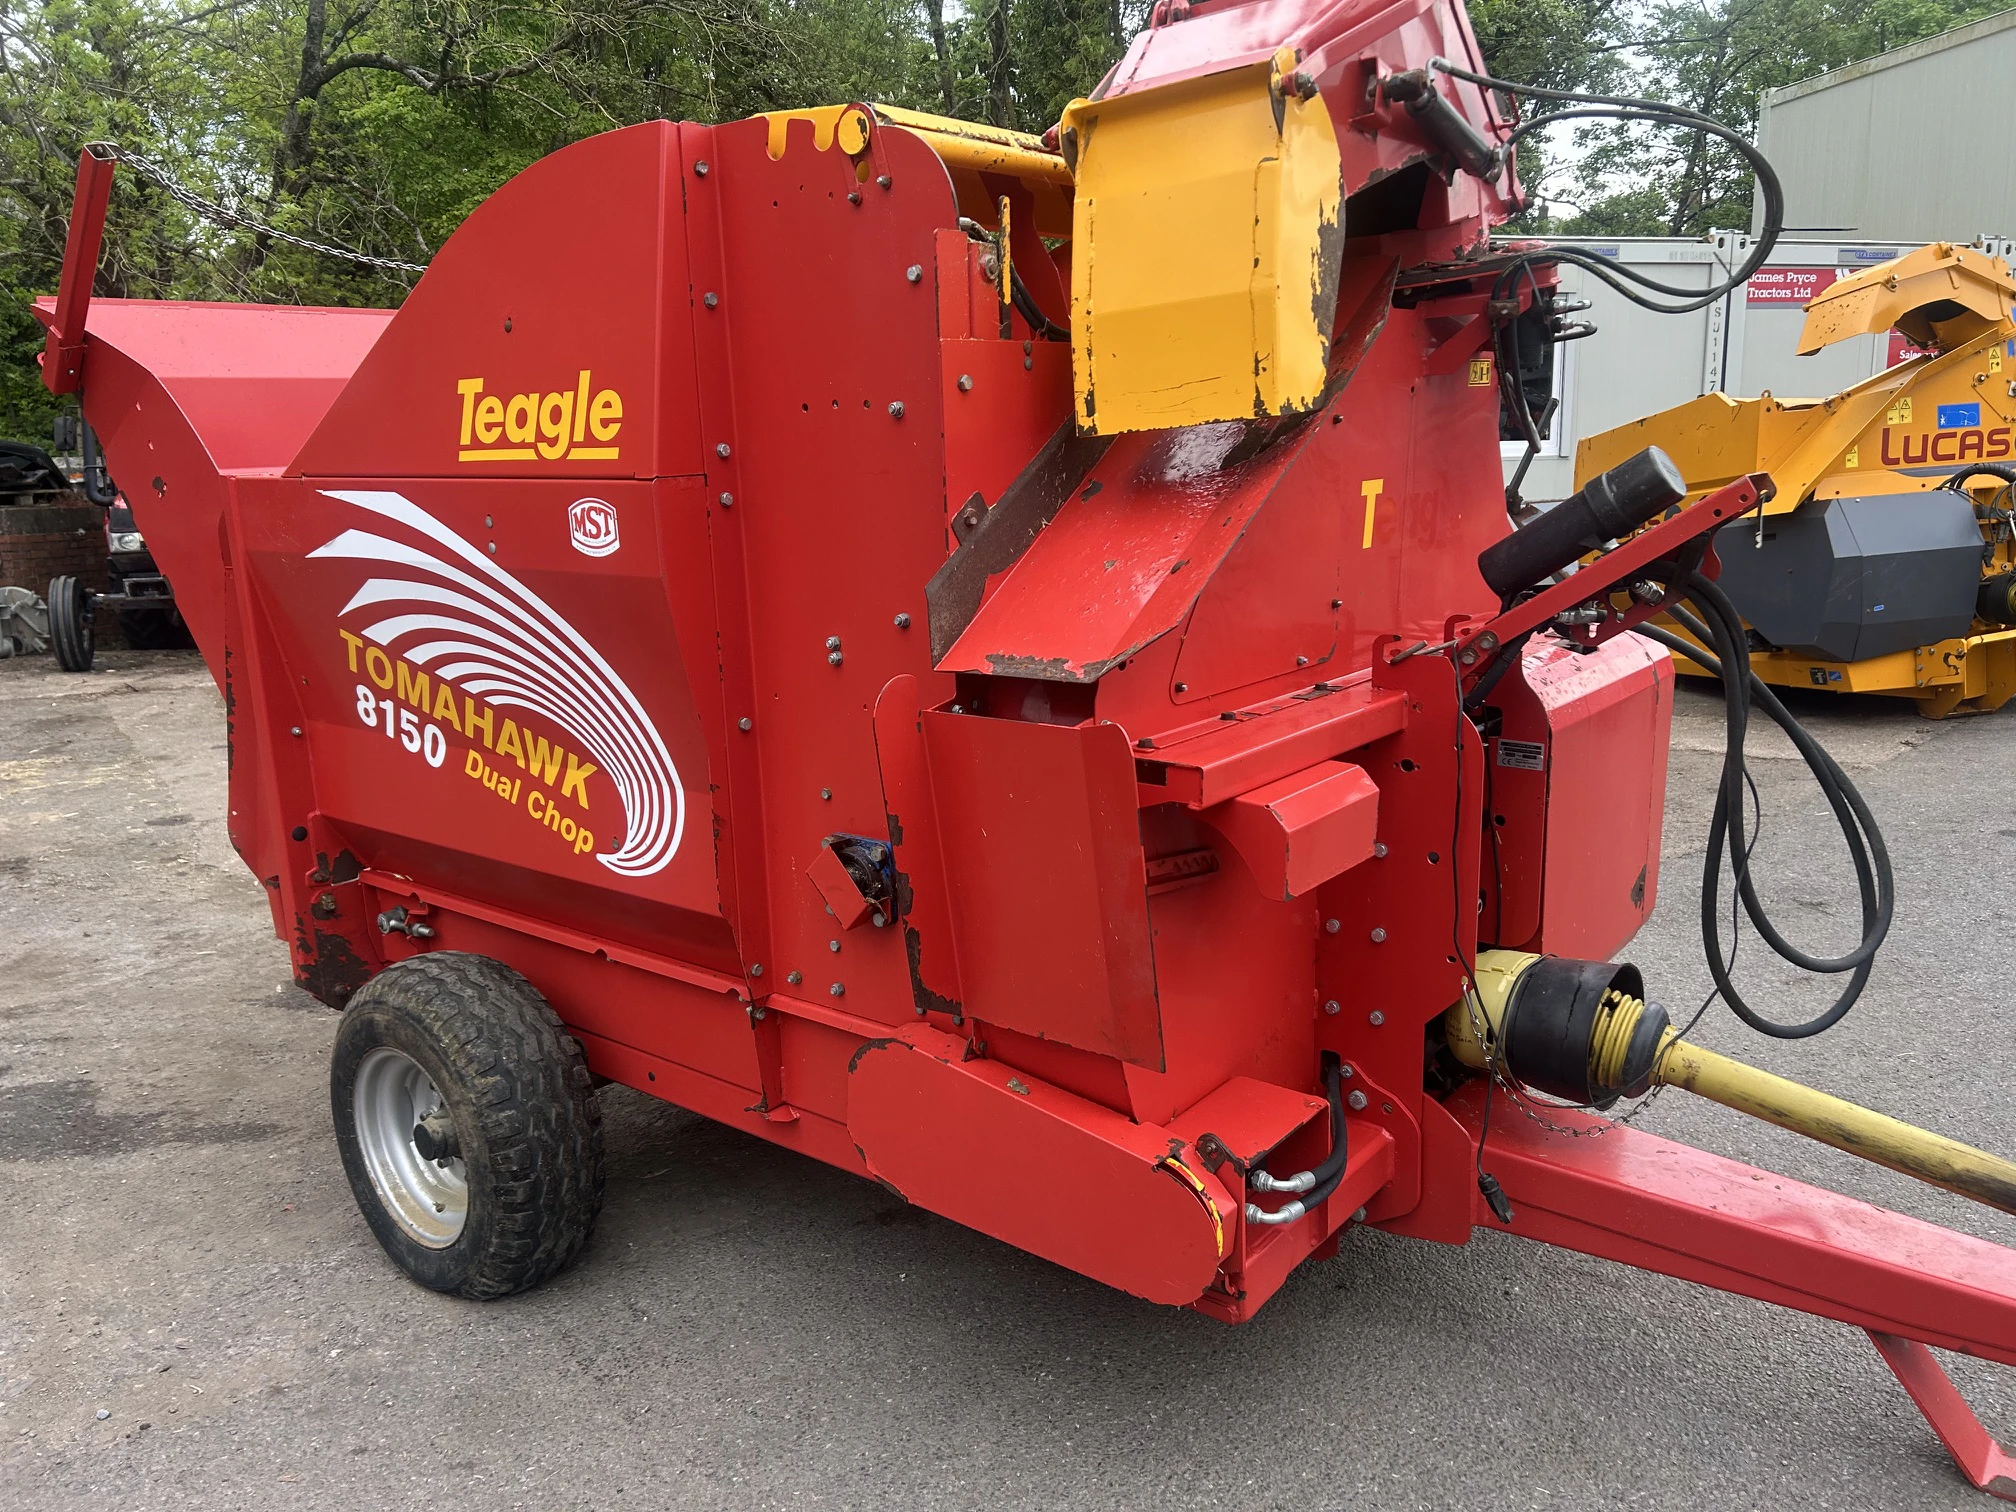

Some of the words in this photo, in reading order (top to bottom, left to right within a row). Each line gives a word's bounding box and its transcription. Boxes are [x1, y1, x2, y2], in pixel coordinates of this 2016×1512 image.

[1748, 288, 1792, 298] Tractors
[1794, 288, 1811, 298] Ltd
[1749, 272, 1784, 283] James
[1787, 272, 1817, 286] Pryce
[457, 370, 623, 460] Teagle
[1881, 428, 2011, 466] LUCAS
[573, 505, 612, 540] MST
[339, 628, 598, 810] TOMAHAWK
[356, 684, 447, 768] 8150
[464, 748, 518, 805] Dual
[526, 791, 594, 854] Chop
